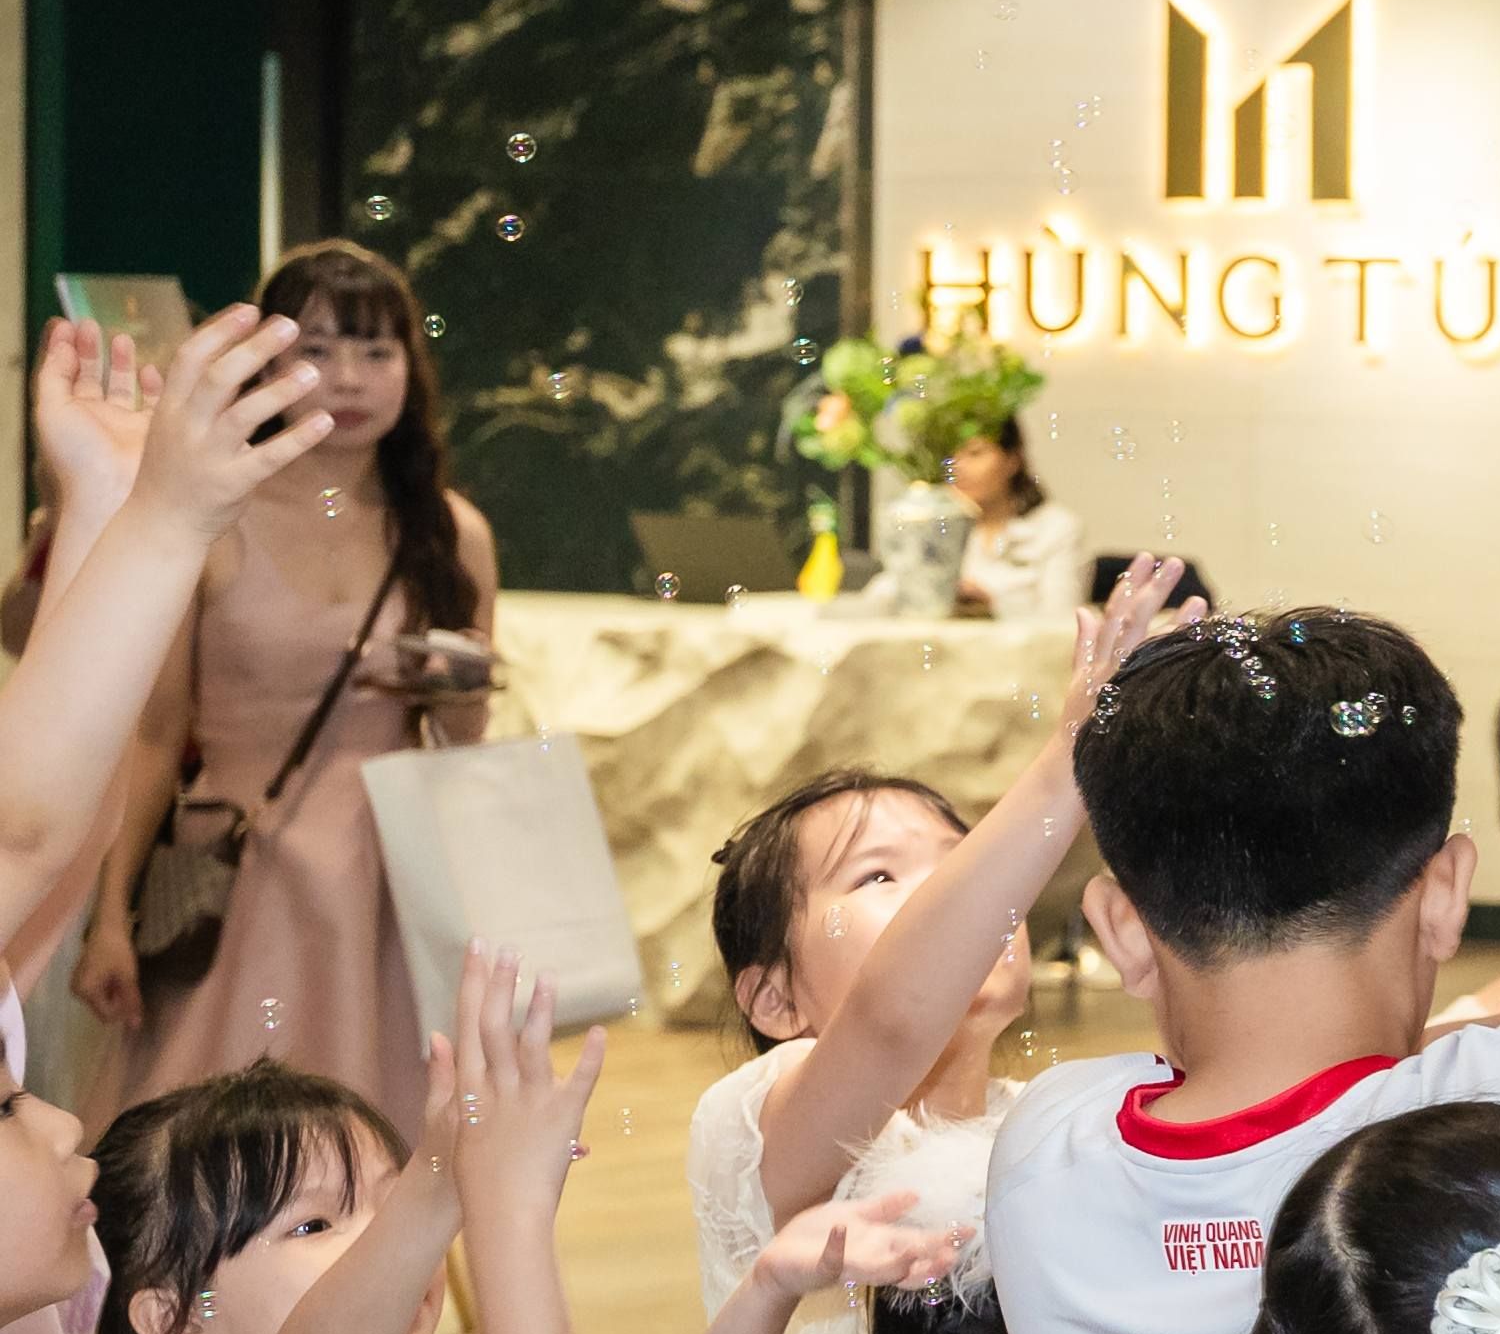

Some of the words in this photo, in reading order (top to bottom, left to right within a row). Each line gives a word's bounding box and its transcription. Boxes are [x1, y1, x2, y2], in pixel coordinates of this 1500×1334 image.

[1163, 1223, 1202, 1244] VINH
[1206, 1219, 1263, 1244] QUANG
[1164, 1243, 1208, 1275] VIỆT
[1212, 1241, 1265, 1270] NAM
